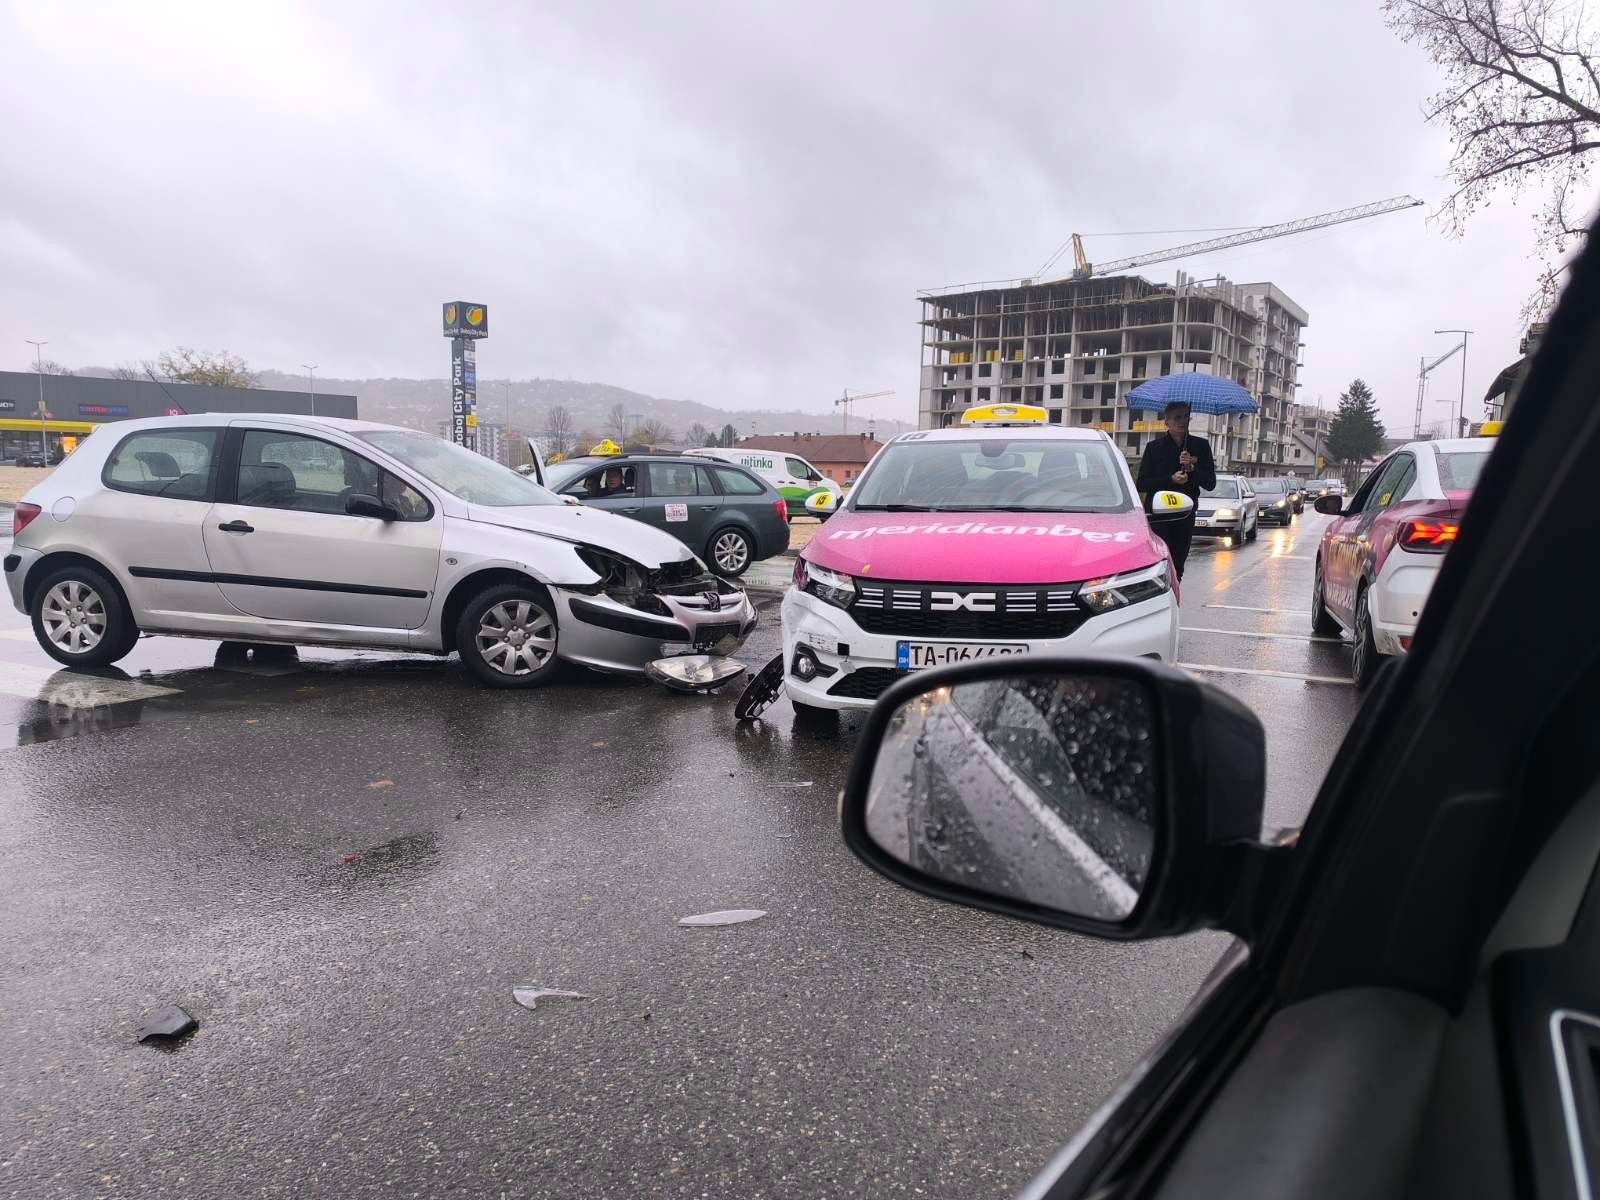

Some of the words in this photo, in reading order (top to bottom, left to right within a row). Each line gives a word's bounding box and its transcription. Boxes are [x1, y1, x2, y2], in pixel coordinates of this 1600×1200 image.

[452, 356, 462, 386] Park
[453, 388, 464, 413] City
[1166, 493, 1178, 506] 15
[828, 522, 1136, 544] meridianbet
[910, 645, 1024, 666] TA-06
